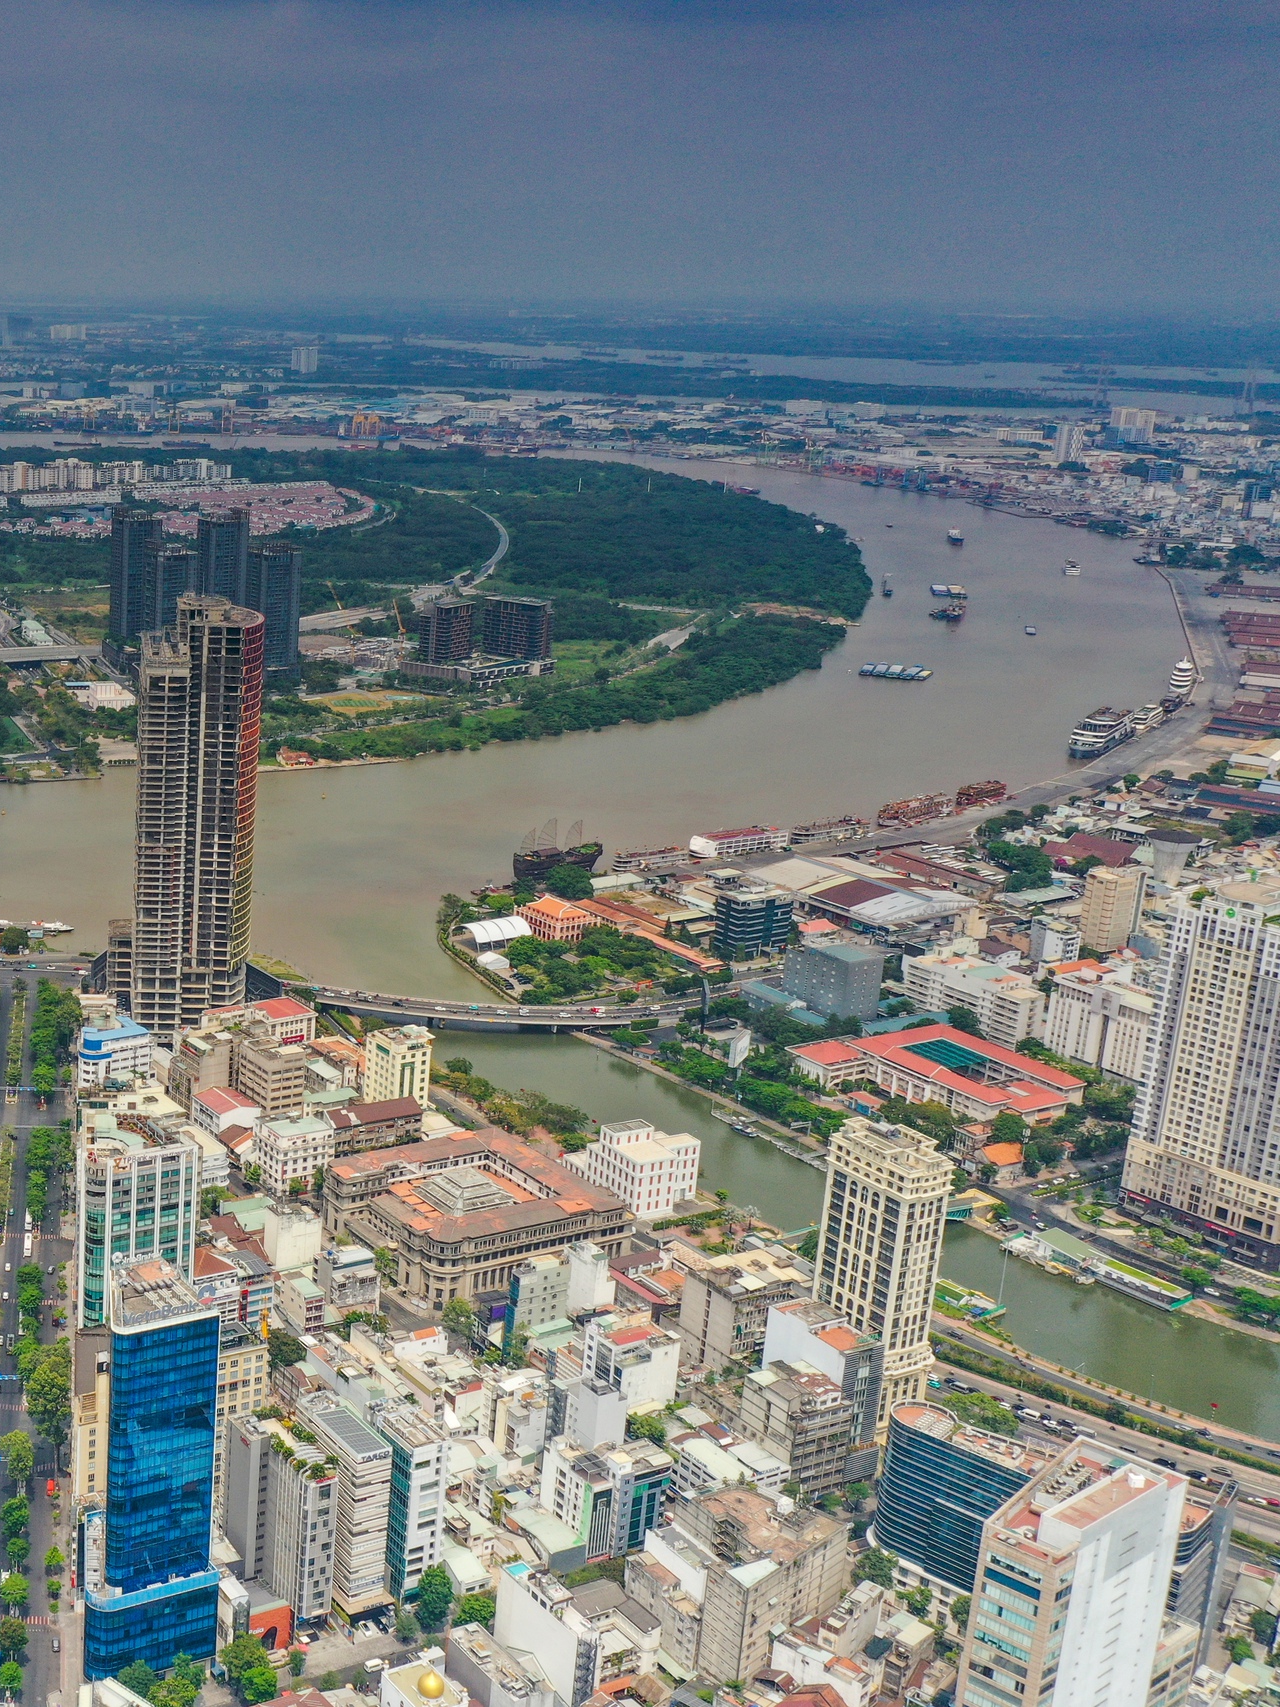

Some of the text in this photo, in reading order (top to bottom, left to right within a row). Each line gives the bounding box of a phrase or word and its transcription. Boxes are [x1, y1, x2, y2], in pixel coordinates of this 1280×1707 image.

[123, 1300, 198, 1324] VietinBank
[361, 1450, 390, 1462] TASCO
[363, 1602, 384, 1610] TASCO
